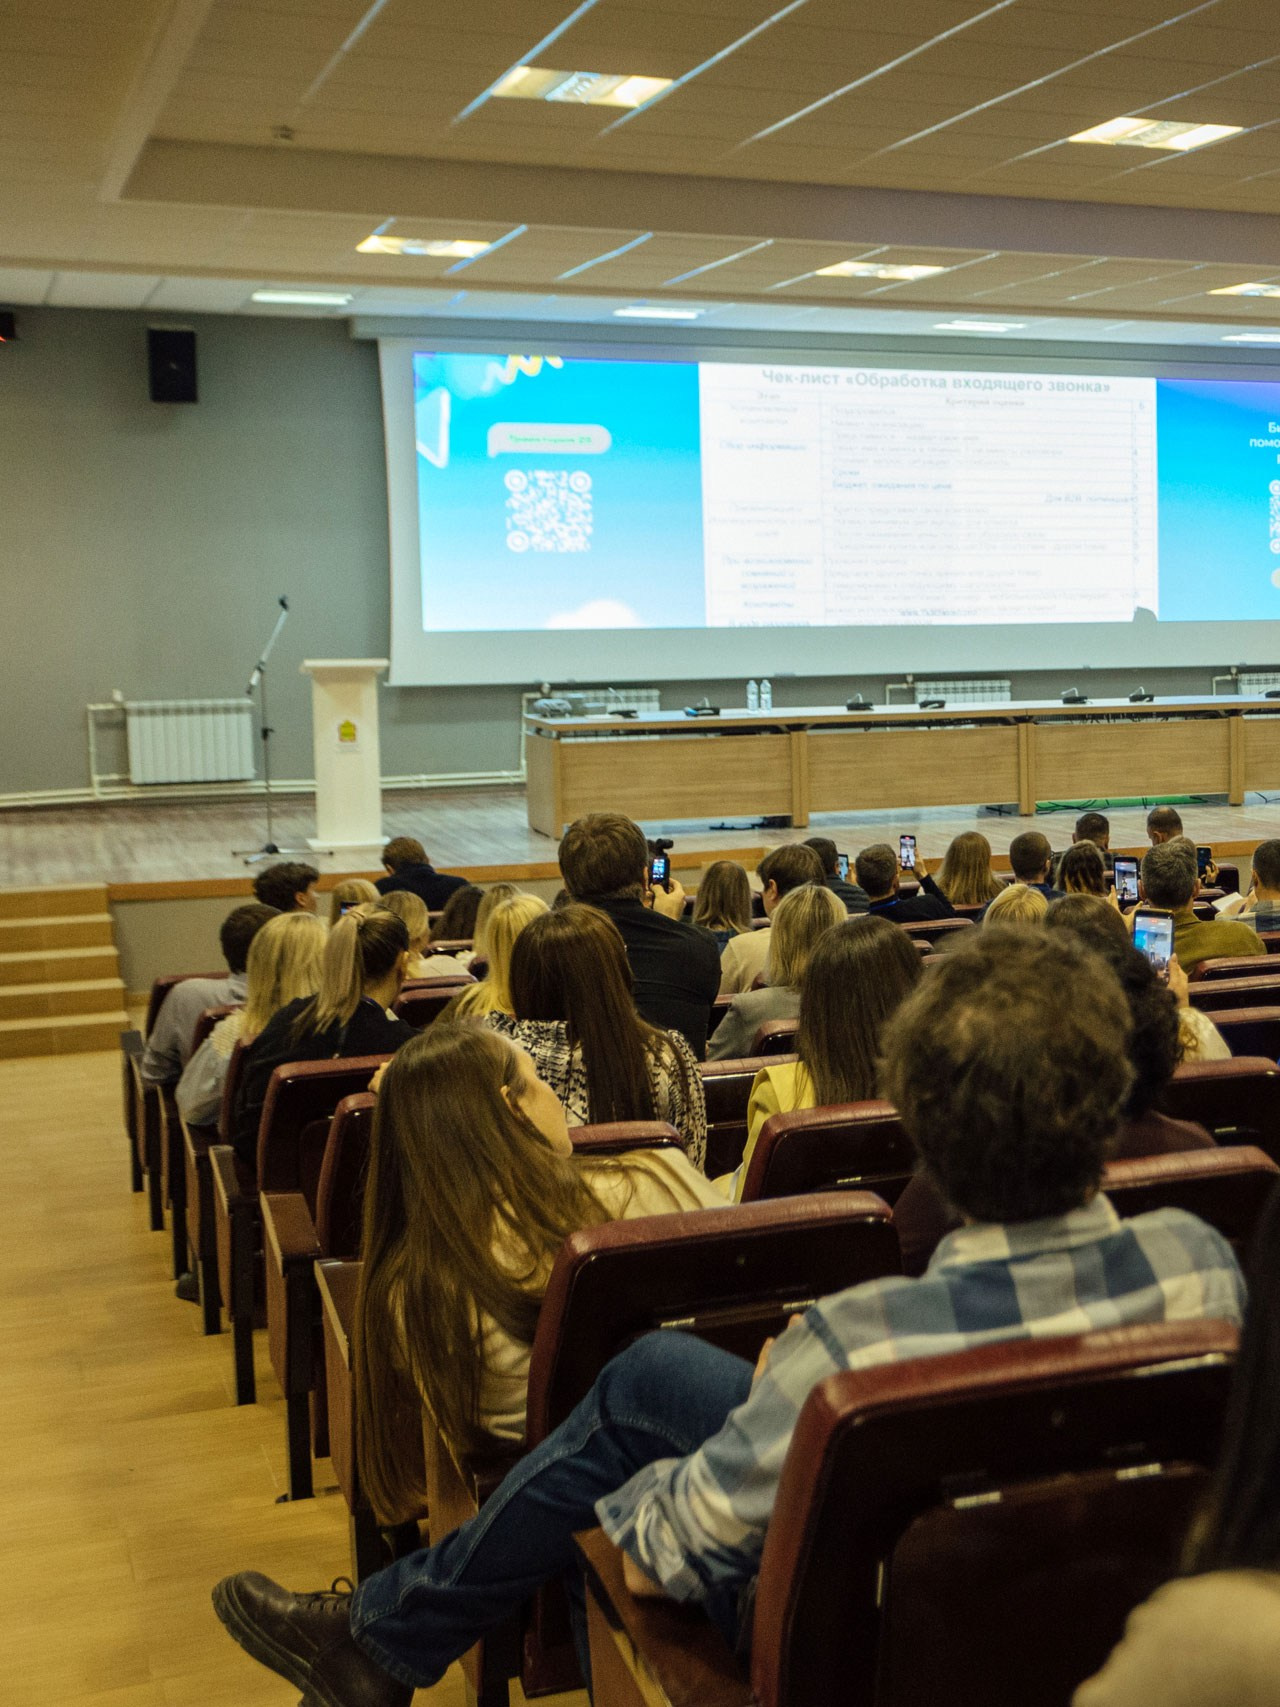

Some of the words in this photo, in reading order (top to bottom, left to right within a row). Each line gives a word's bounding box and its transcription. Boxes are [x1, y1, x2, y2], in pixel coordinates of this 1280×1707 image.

[762, 369, 840, 385] Чек-лист
[846, 372, 947, 389] «Обработка
[952, 378, 1043, 392] входящего
[1048, 381, 1110, 393] звонка»
